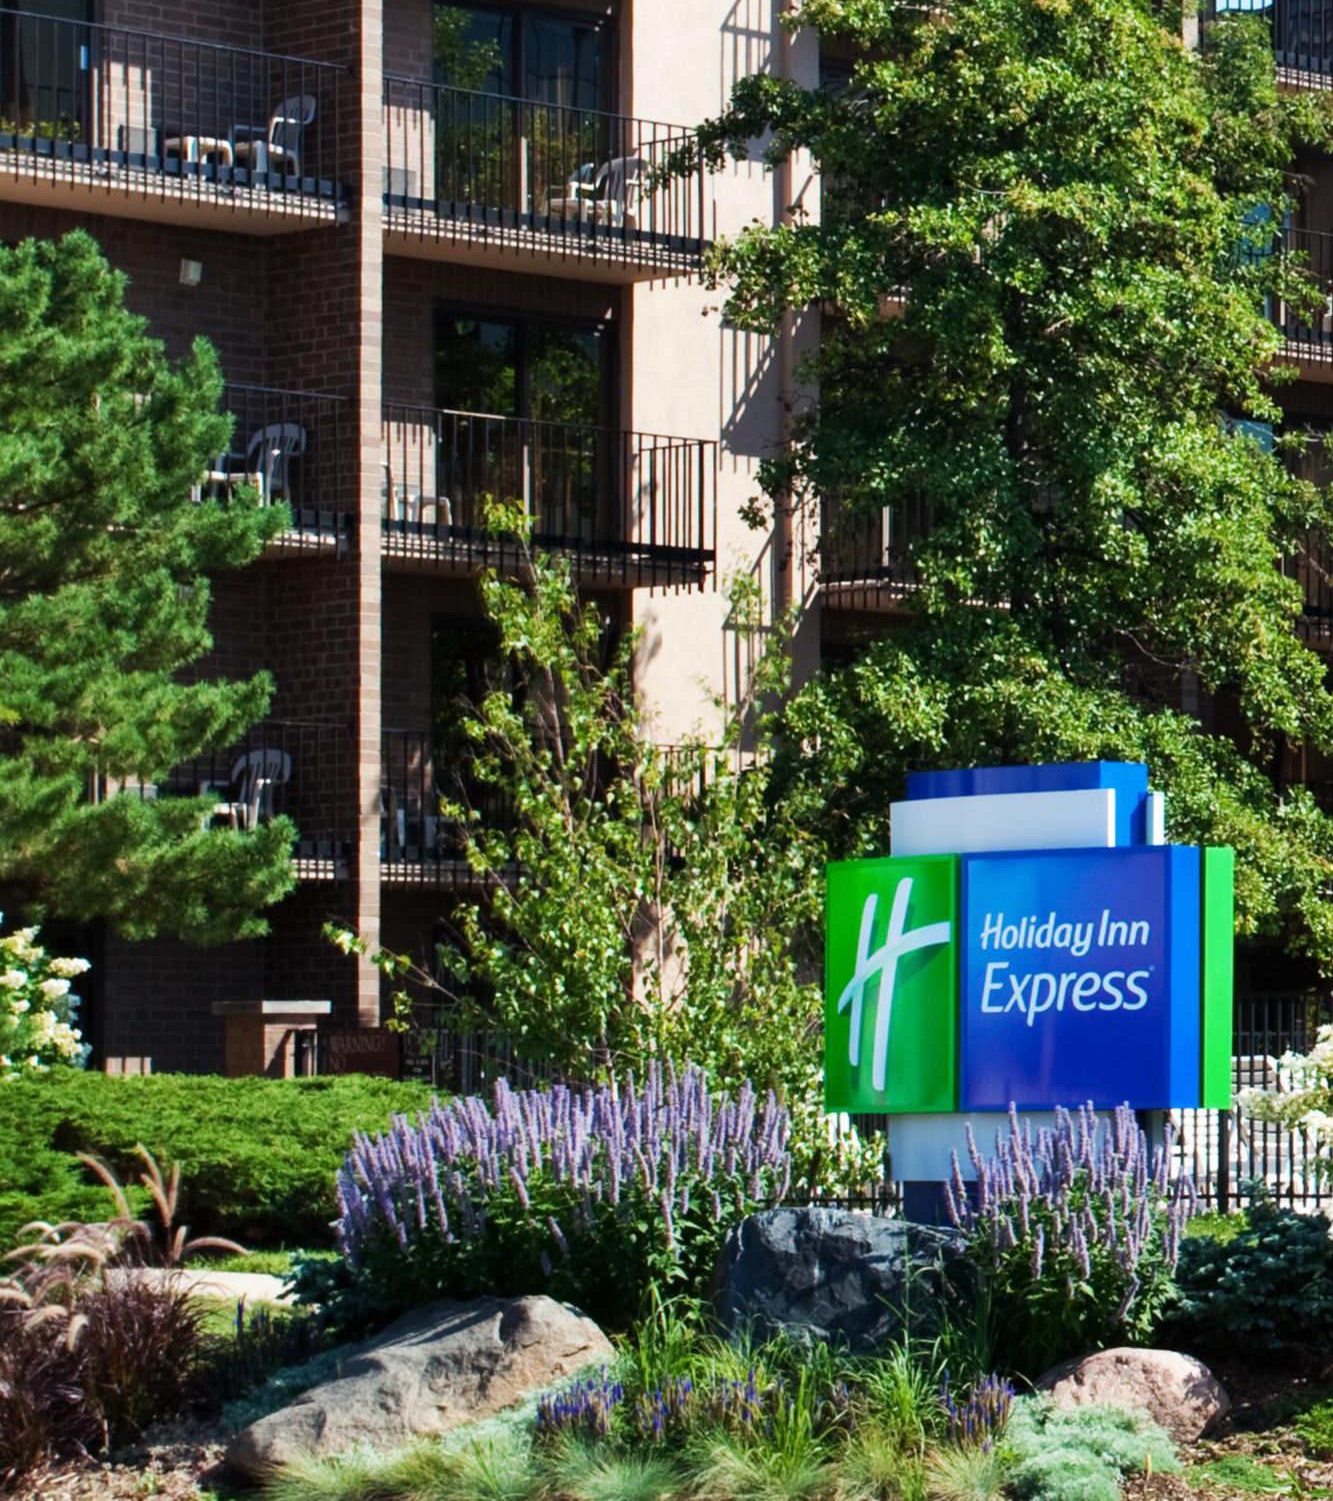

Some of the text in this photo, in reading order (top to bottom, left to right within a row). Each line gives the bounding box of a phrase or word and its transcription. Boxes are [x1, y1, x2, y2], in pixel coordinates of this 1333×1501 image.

[980, 908, 1150, 957] Holiday Inn
[838, 877, 951, 1092] H
[980, 961, 1150, 1027] Express
